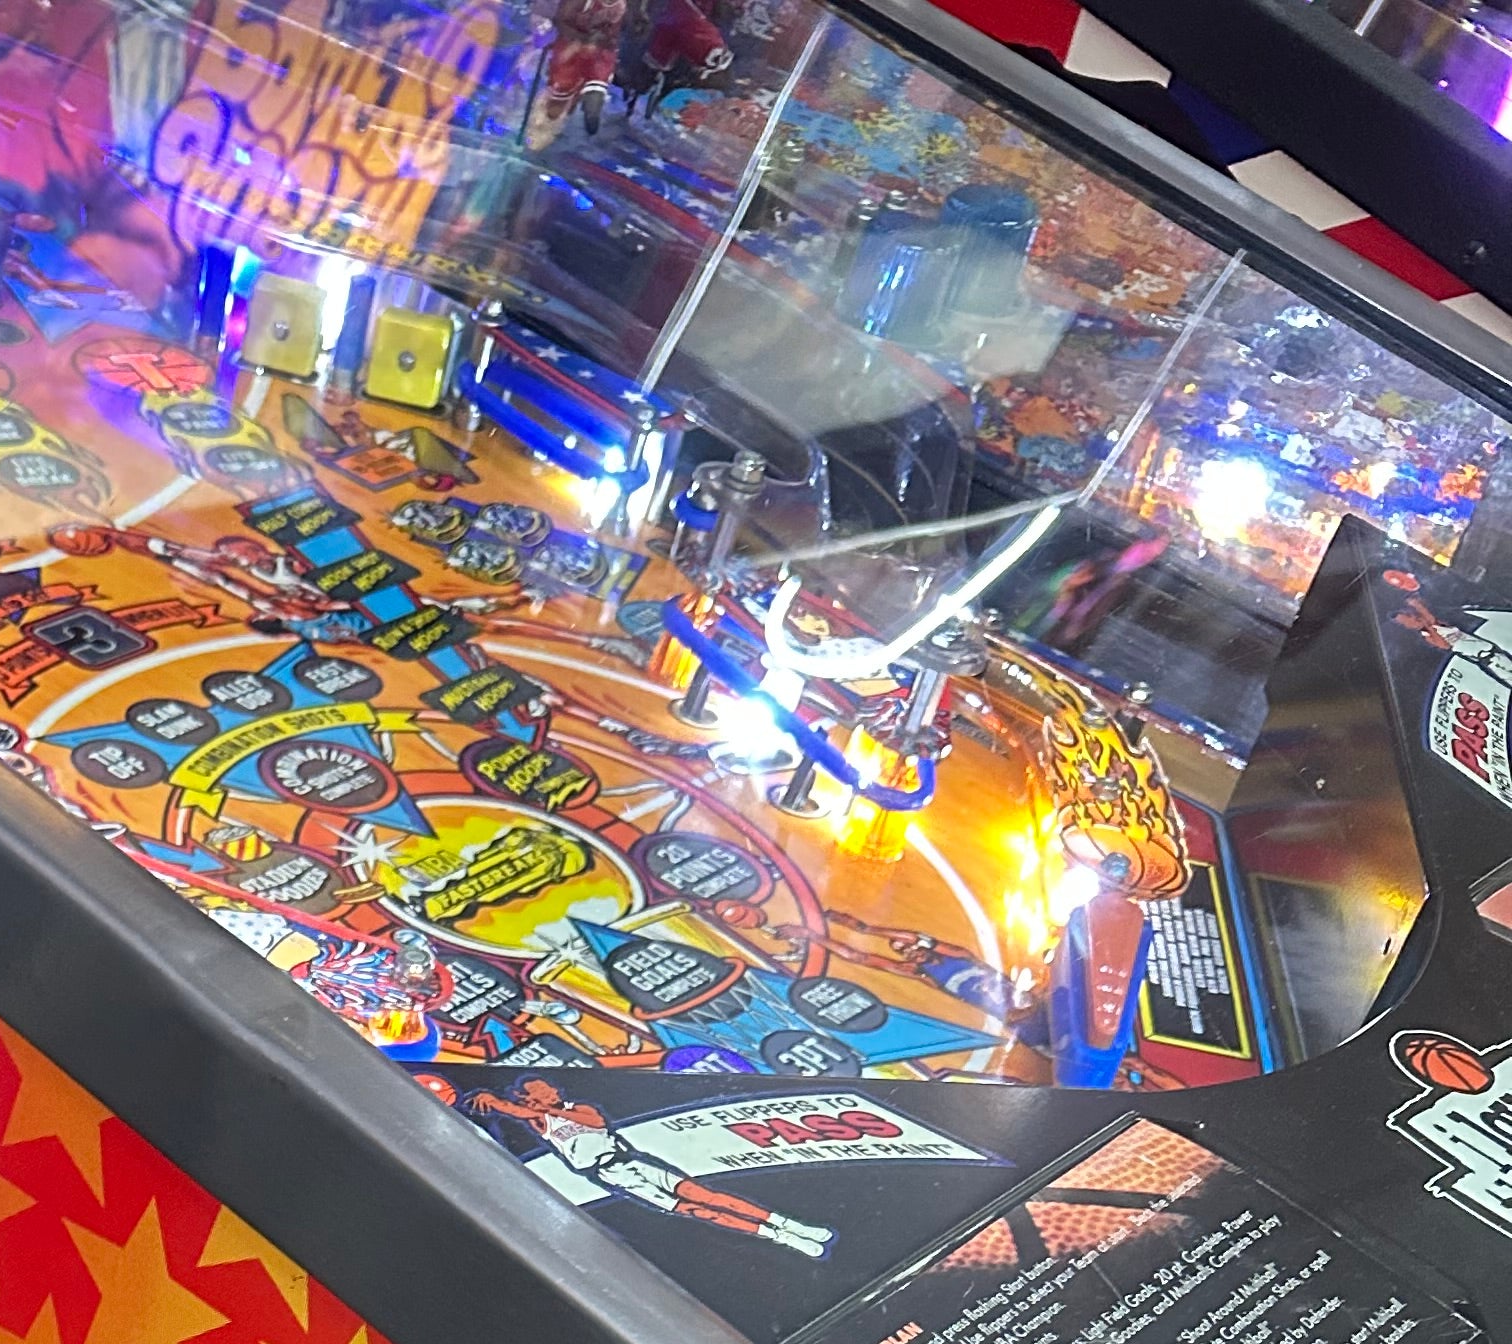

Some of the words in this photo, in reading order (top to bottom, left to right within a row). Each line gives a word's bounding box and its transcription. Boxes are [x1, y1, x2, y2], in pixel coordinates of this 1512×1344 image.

[210, 674, 263, 703] ALLEY
[1448, 668, 1463, 684] TO
[137, 703, 185, 728] SLAM
[1434, 680, 1458, 727] FLIPPERS
[156, 714, 205, 740] DUNK
[187, 724, 285, 778] COMBINATION
[286, 706, 347, 733] SHOTS
[1433, 726, 1449, 757] USE
[1450, 692, 1491, 785] PASS
[1491, 728, 1505, 751] THE
[478, 743, 532, 781] POWER
[503, 752, 553, 796] HOOPS
[412, 849, 467, 880] NBA
[657, 844, 692, 864] 20
[661, 848, 736, 890] POINTS
[239, 856, 314, 894] STADIUM
[257, 867, 329, 902] GOODIES
[437, 848, 550, 915] FASTBREAK
[613, 943, 672, 977] FIELD
[630, 954, 697, 992] GOALS
[450, 985, 517, 1024] COMPLETE
[778, 1036, 851, 1078] 3PT
[661, 1114, 712, 1133] USE
[713, 1099, 816, 1124] FLIPPERS
[824, 1096, 858, 1112] TO
[726, 1110, 904, 1148] PASS
[711, 1150, 778, 1169] WHEN
[824, 1143, 883, 1161] THE
[1080, 1320, 1108, 1343] Light
[1100, 1301, 1130, 1325] Field
[1153, 1268, 1174, 1285] 20
[1221, 1210, 1253, 1233] Power
[1152, 1293, 1175, 1315] and
[1247, 1229, 1262, 1240] to
[1258, 1215, 1282, 1236] play
[942, 1318, 971, 1342] press
[963, 1293, 1009, 1321] flashing
[1000, 1276, 1028, 1296] Start
[977, 1309, 1019, 1335] flippers
[1013, 1301, 1030, 1312] to
[1026, 1281, 1055, 1305] select
[1051, 1267, 1075, 1289] your
[1068, 1250, 1100, 1270] Team
[1207, 1291, 1245, 1324] Around
[1220, 1295, 1278, 1340] Combination
[1299, 1267, 1311, 1279] or
[1309, 1249, 1331, 1272] spell
[1286, 1325, 1309, 1339] by
